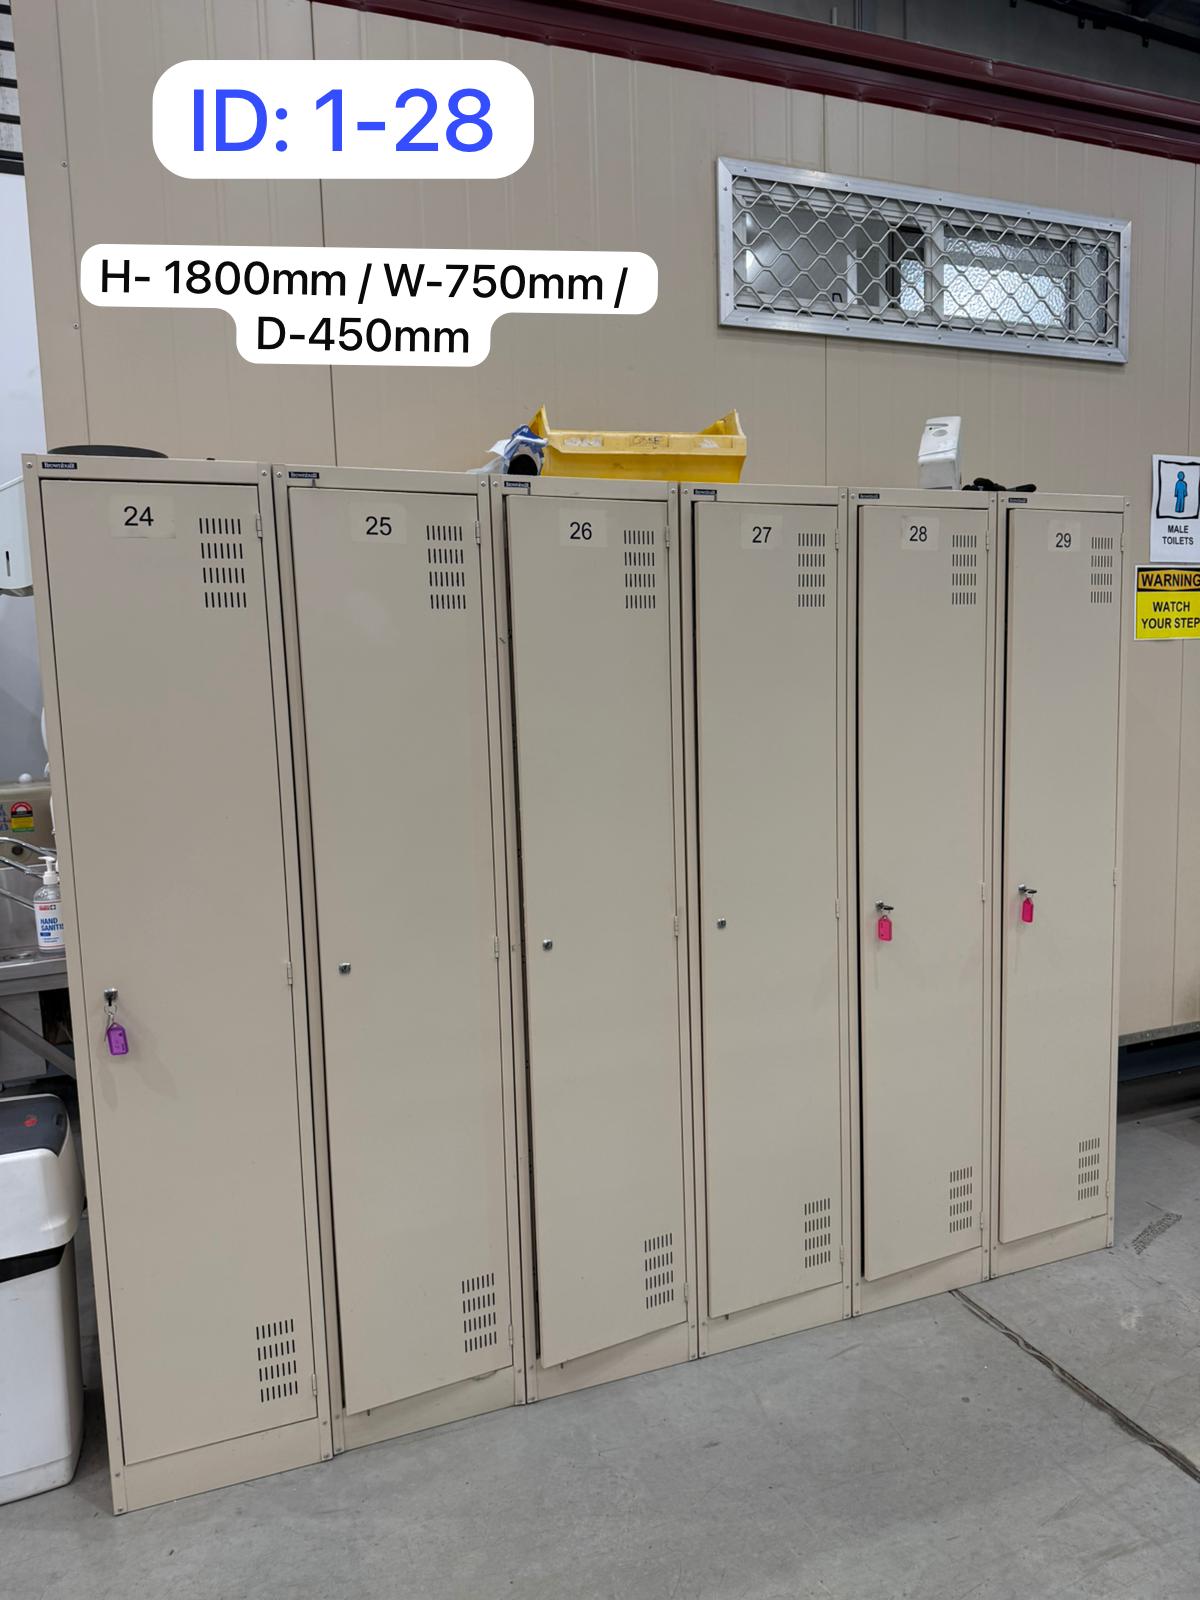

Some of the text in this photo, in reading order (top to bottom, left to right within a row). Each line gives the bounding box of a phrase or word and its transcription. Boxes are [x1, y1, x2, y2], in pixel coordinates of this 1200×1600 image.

[123, 505, 155, 527] 24
[365, 515, 393, 536] 25
[569, 521, 593, 541] 26
[1167, 525, 1189, 534] MALE
[752, 526, 772, 544] 27
[909, 525, 928, 542] 28
[1055, 532, 1072, 549] 29
[1162, 536, 1194, 545] TOILETS
[1140, 573, 1200, 587] WARNING
[1152, 601, 1191, 613] WATCH
[1141, 616, 1200, 630] YOUR STEP
[40, 917, 58, 925] HAND
